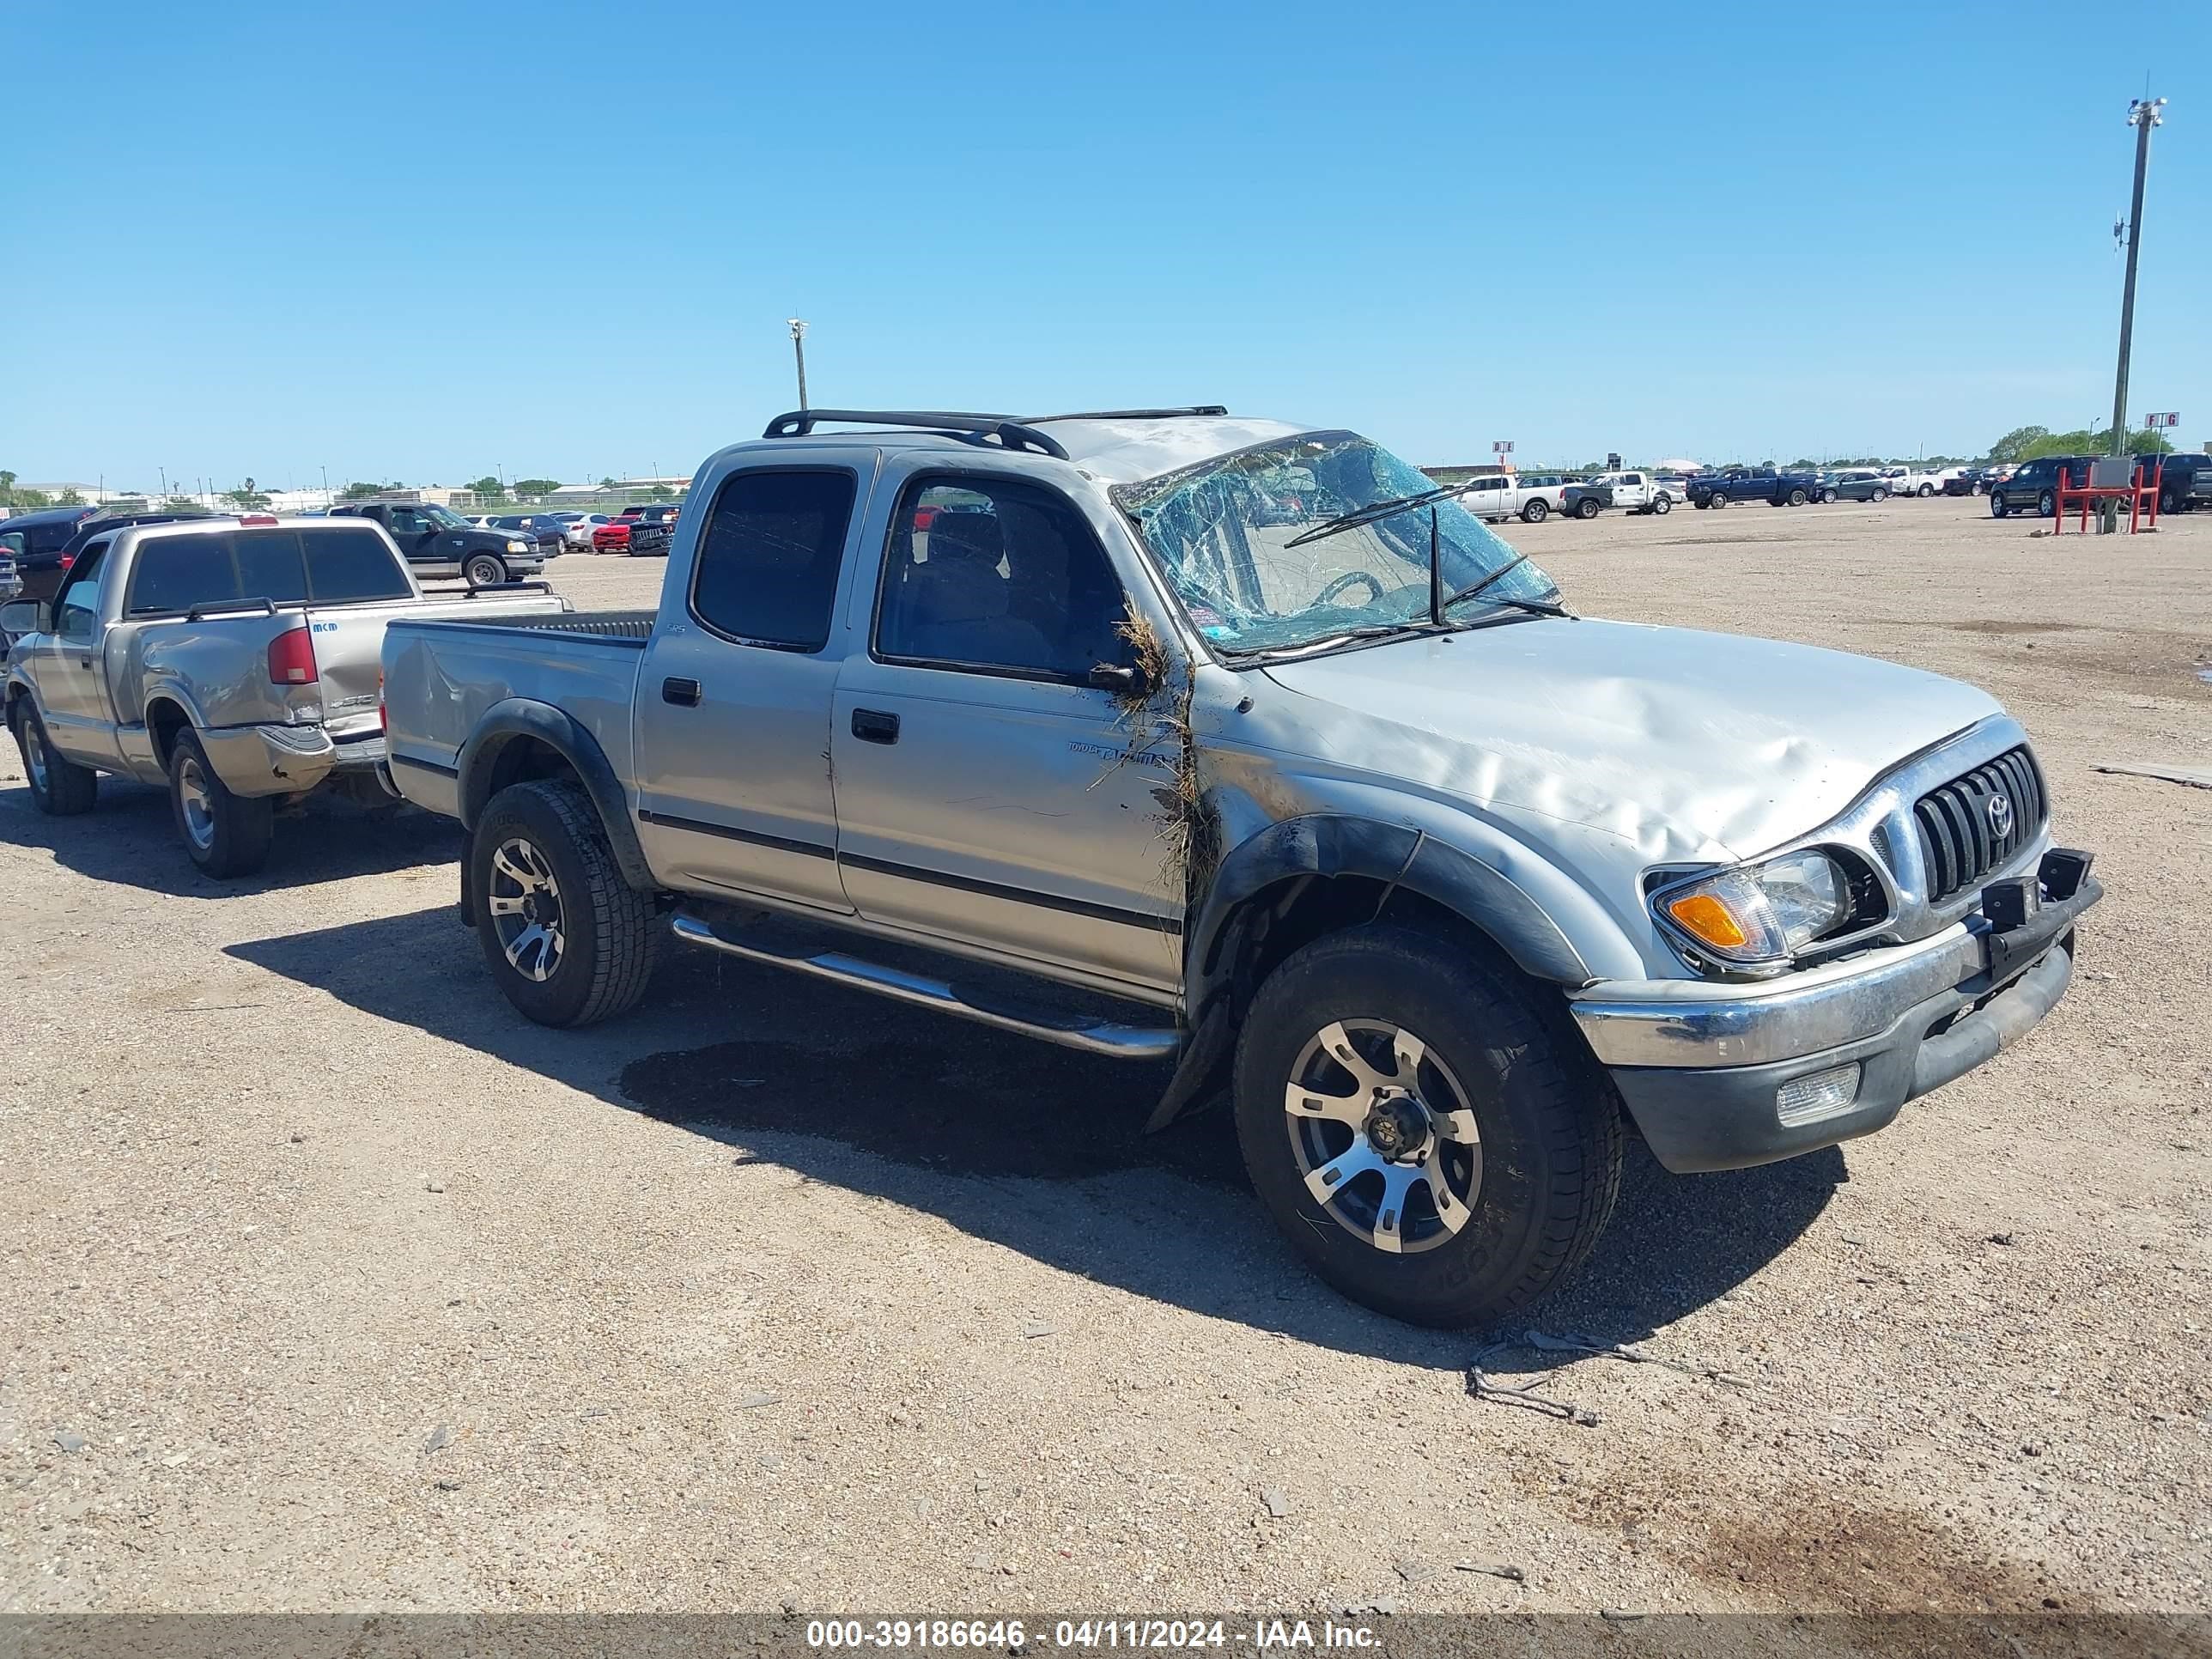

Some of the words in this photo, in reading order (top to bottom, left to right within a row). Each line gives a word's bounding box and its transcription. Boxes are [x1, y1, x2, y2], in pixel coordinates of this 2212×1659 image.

[2148, 415, 2155, 427] F
[2168, 413, 2176, 426] G
[1068, 741, 1098, 754] TOYOTA
